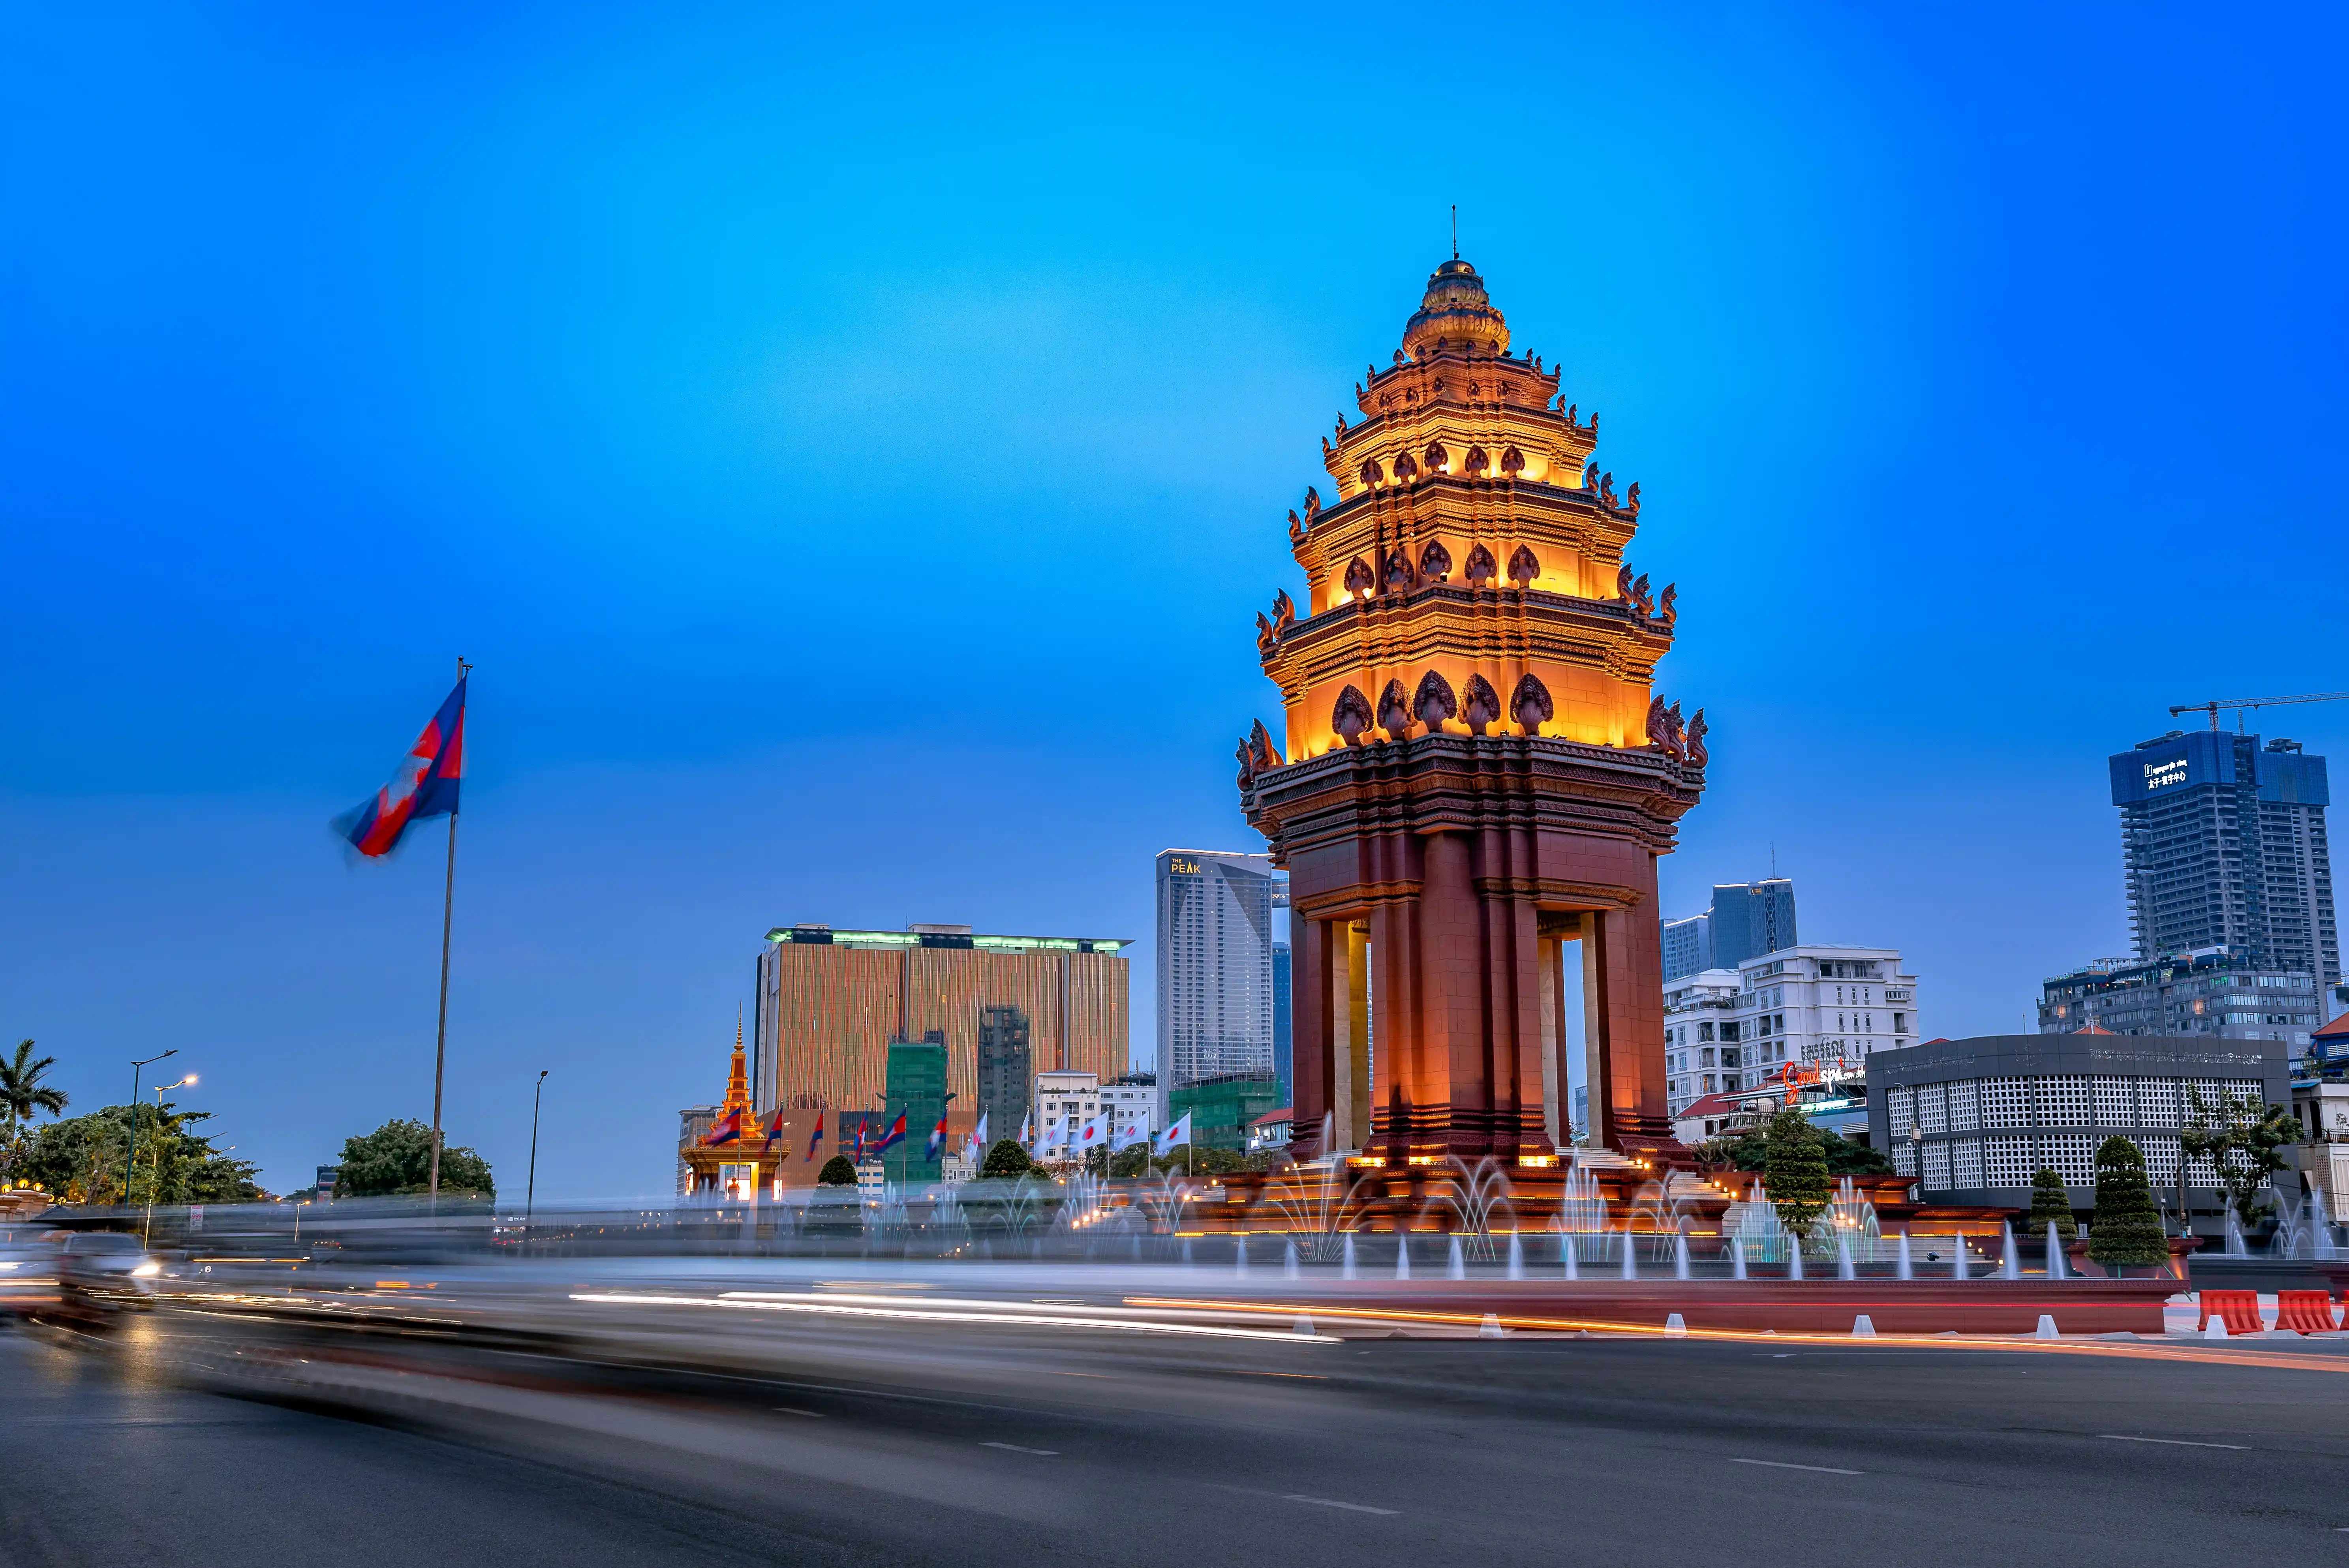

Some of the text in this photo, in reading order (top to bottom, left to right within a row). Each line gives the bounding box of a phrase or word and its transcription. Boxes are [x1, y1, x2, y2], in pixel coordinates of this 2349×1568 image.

[1172, 861, 1200, 874] PEAK
[2089, 1048, 2114, 1060] FIRST
[2117, 1050, 2177, 1062] INVESTMENT
[2236, 1054, 2263, 1065] BANK
